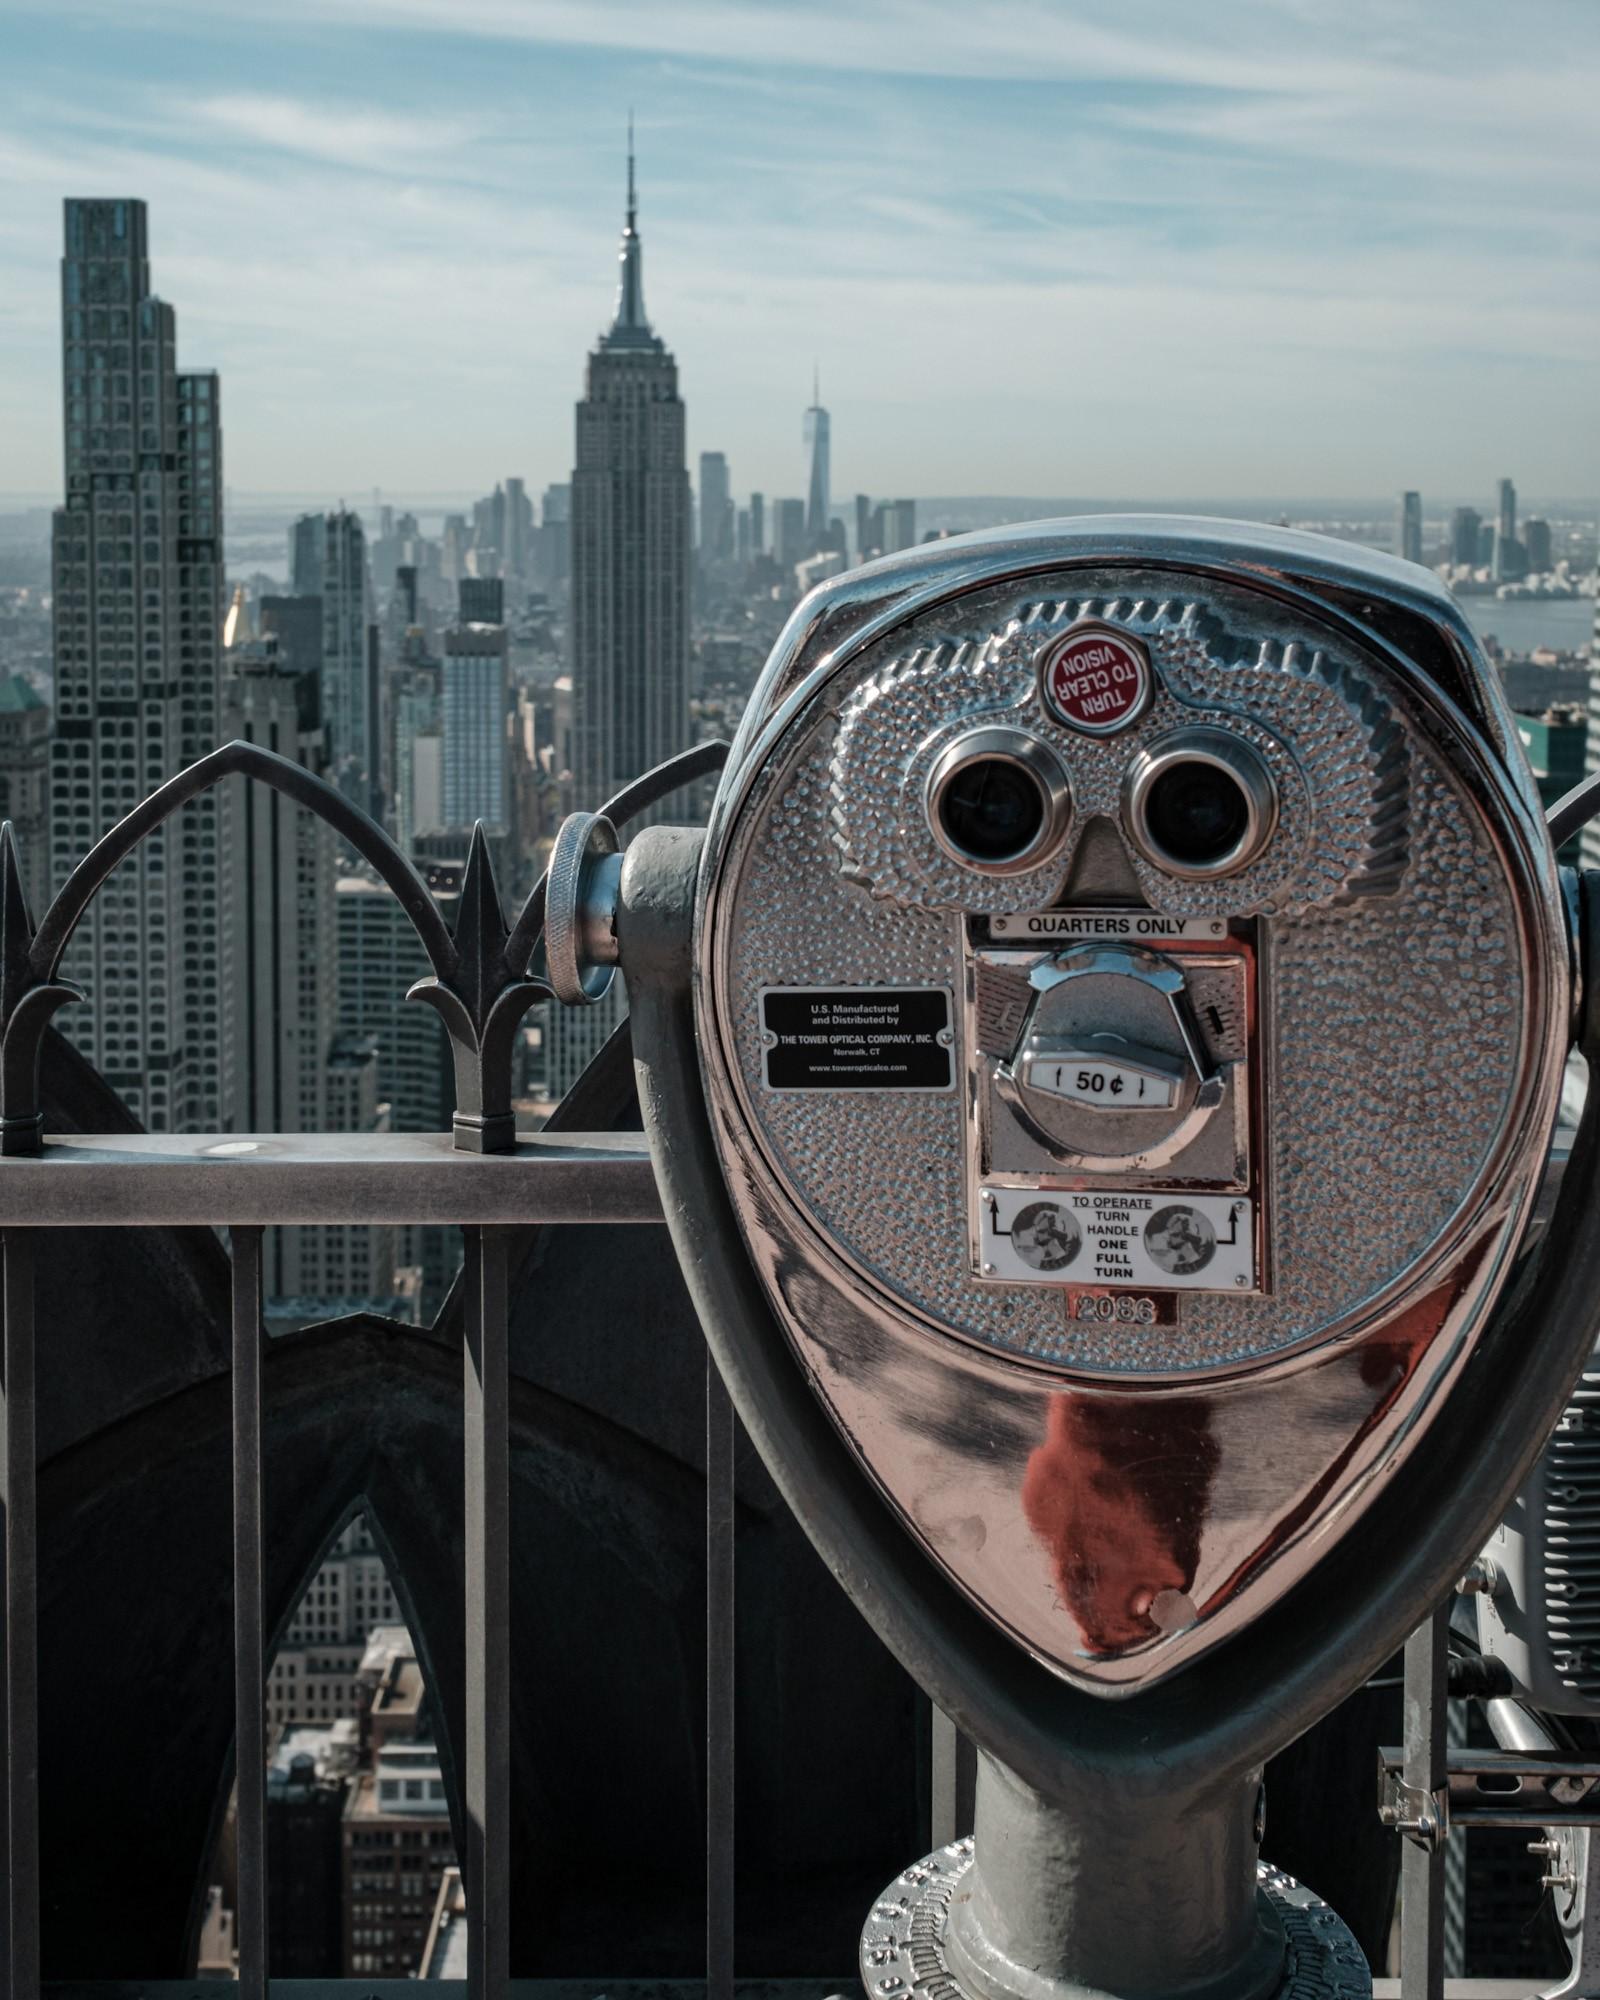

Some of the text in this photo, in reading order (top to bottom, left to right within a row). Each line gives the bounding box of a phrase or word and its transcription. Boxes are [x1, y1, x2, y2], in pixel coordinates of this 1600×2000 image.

[1061, 646, 1116, 676] VISION
[1057, 662, 1136, 700] TO CLEAR
[1080, 689, 1126, 716] TURN
[1028, 917, 1187, 935] QUARTERS ONLY
[811, 1004, 900, 1014] U.S. Manufactured
[812, 1015, 900, 1026] and Distributed by
[780, 1034, 934, 1045] THE TOWER OPTICAL COMPANY, INC.
[833, 1048, 881, 1057] Norwalk, CT
[809, 1064, 908, 1073] www.toweropticalco.com
[1072, 1196, 1152, 1209] TO OPERATE
[1096, 1211, 1130, 1222] TURN
[1087, 1224, 1139, 1237] HANDLE
[1099, 1239, 1128, 1250] ONE
[1096, 1253, 1131, 1264] FULL
[1094, 1267, 1133, 1278] TURN
[1077, 1296, 1157, 1324] 2086
